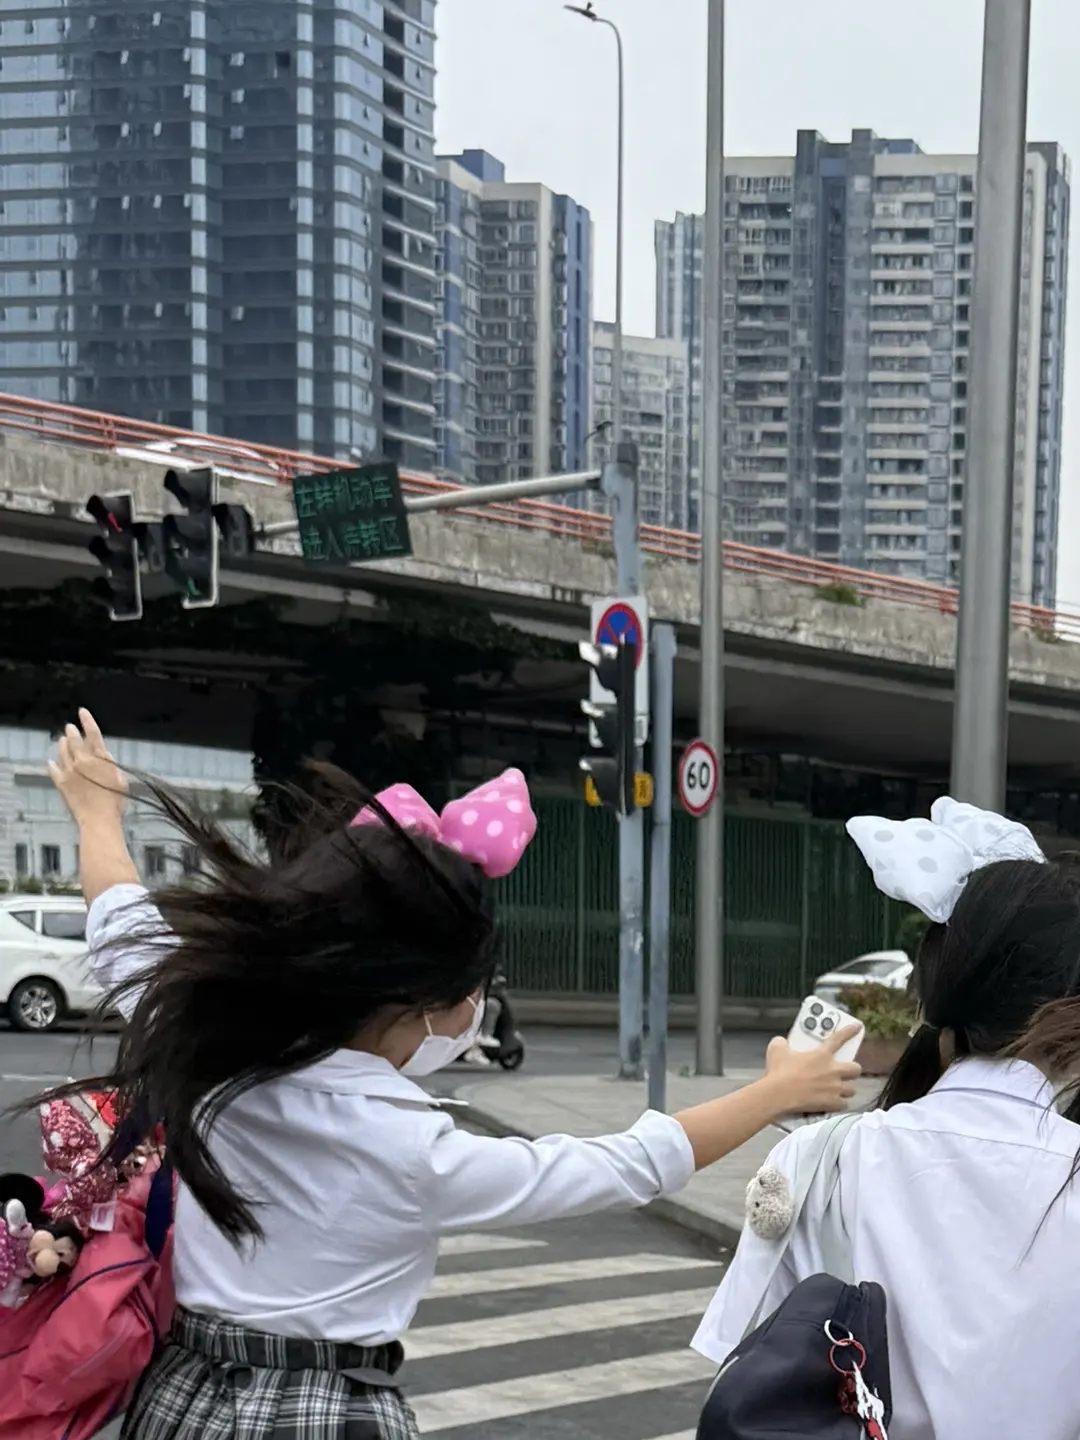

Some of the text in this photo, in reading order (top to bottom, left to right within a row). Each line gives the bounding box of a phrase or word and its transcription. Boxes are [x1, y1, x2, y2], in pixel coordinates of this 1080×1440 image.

[296, 474, 393, 517] 左转机动车
[687, 761, 710, 790] 60
